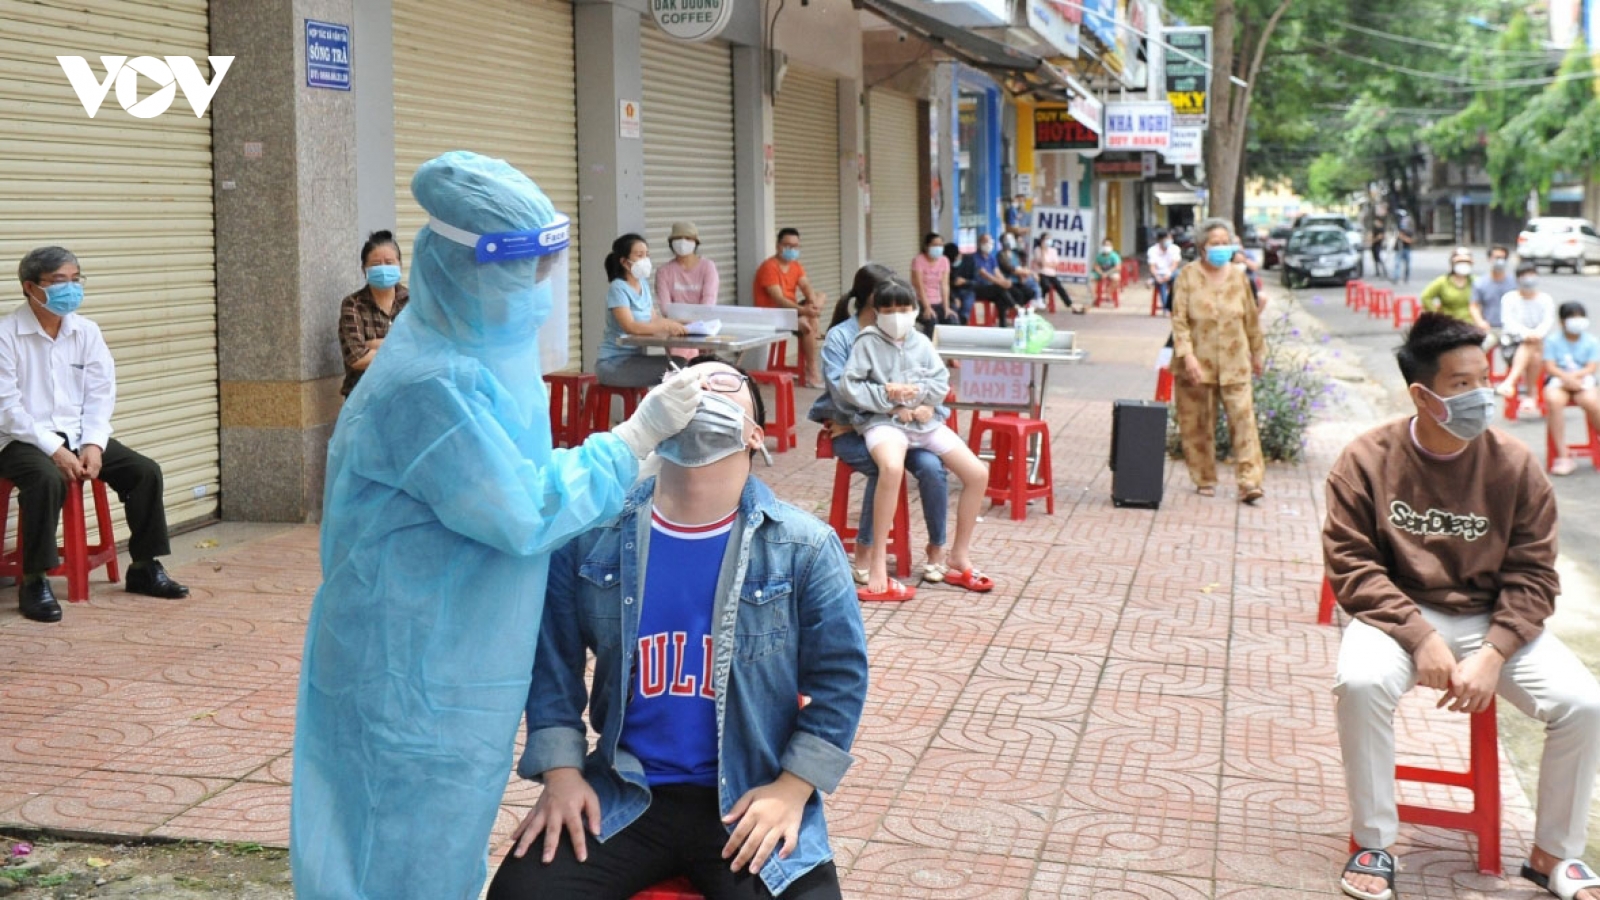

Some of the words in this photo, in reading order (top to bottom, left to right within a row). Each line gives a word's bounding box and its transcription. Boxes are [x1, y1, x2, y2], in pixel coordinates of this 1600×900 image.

[661, 12, 712, 24] COFFEE
[310, 42, 330, 62] SÔNG
[331, 46, 348, 64] TRÀ
